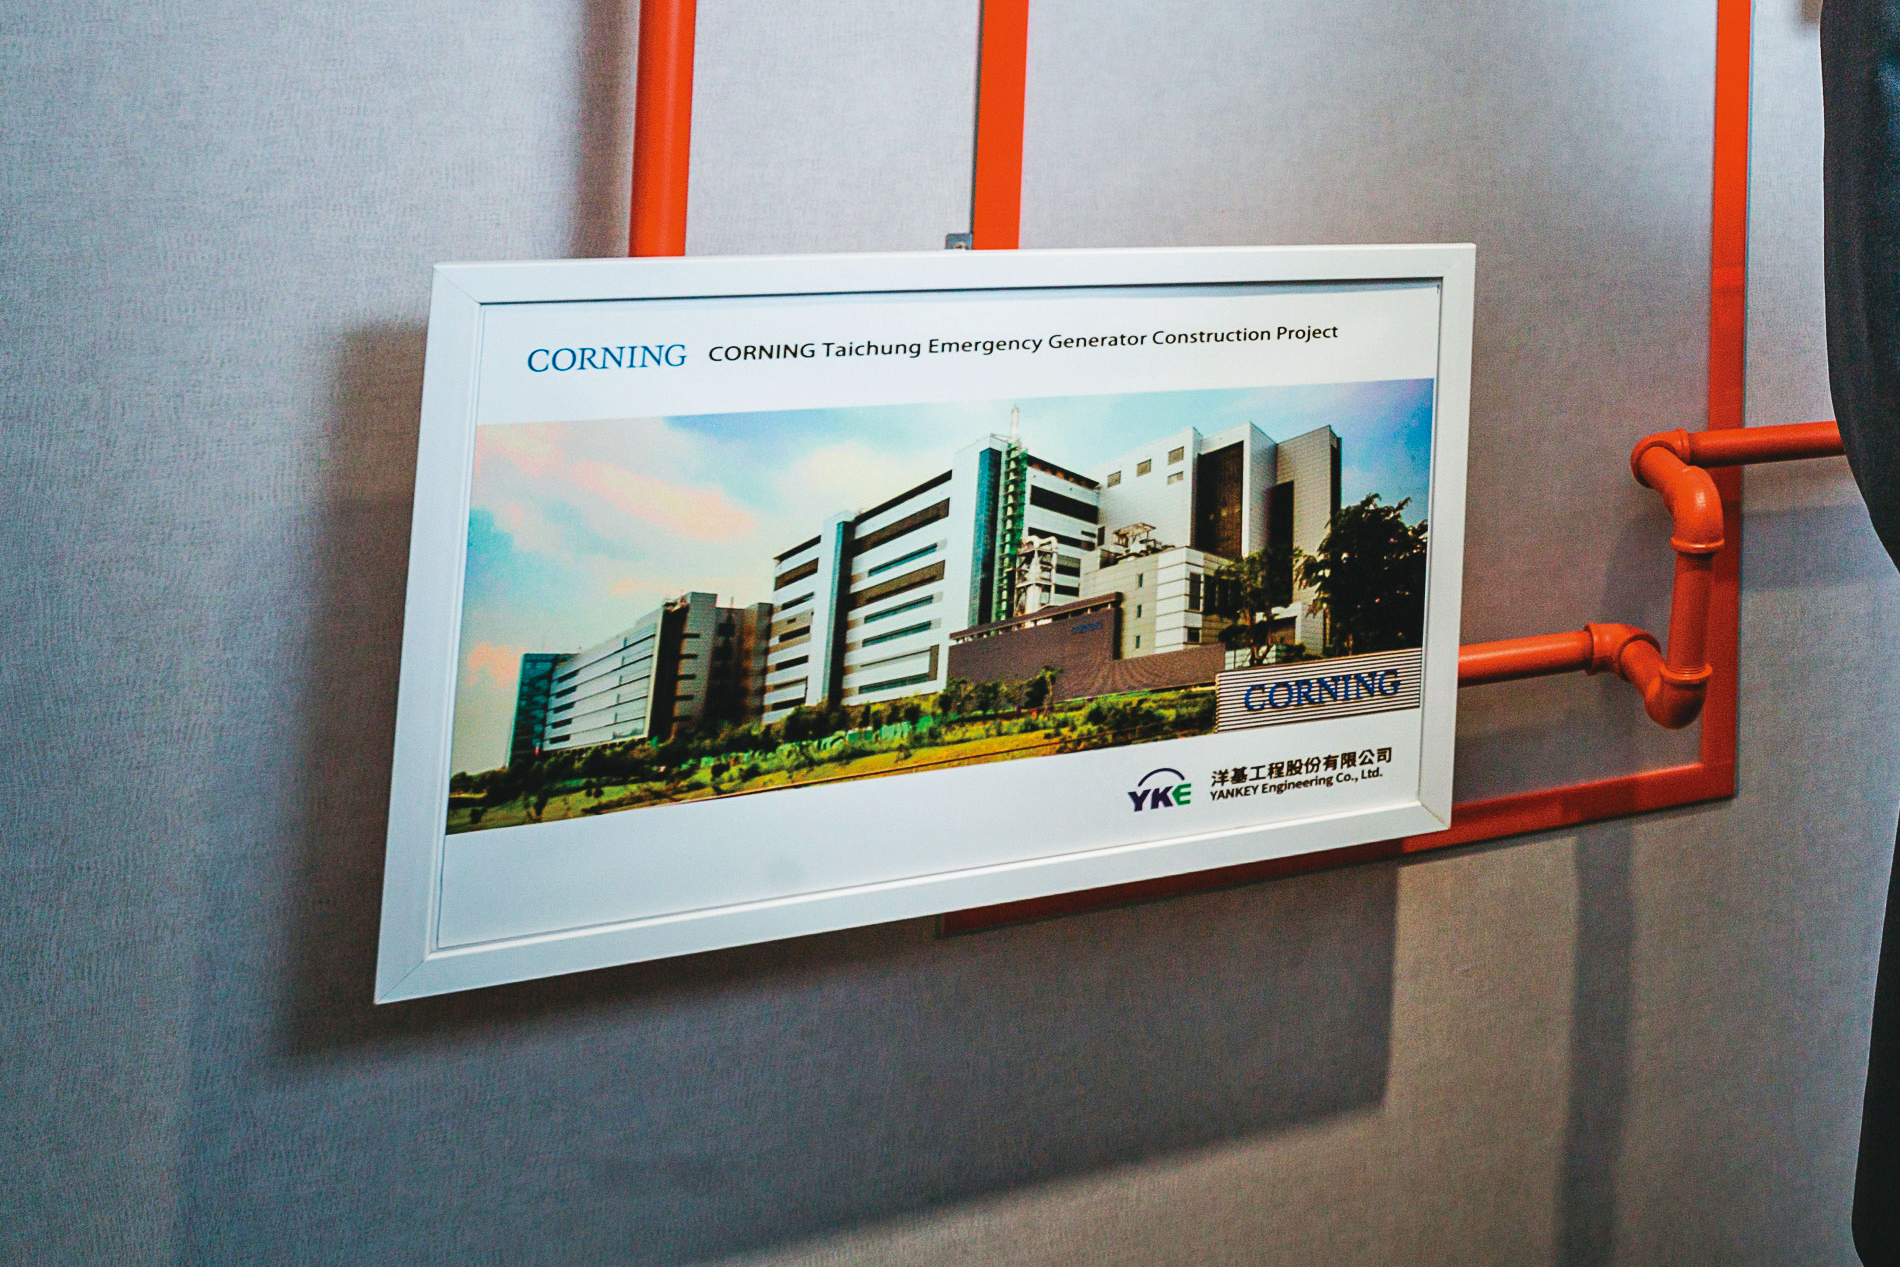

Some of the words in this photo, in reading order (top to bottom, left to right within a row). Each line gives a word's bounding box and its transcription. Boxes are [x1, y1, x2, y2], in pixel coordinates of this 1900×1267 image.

[526, 343, 688, 373] CORNING
[708, 342, 816, 362] CORNING
[821, 340, 922, 359] Taichung
[928, 336, 1043, 356] Emergency
[1048, 332, 1148, 350] Generator
[1152, 327, 1272, 346] Construction
[1276, 325, 1339, 343] Project
[1243, 668, 1400, 712] CORNING
[1210, 746, 1393, 788] 洋基工程股份有限公司
[1210, 785, 1259, 801] YANKEY
[1261, 775, 1334, 795] Engineering
[1335, 771, 1359, 784] Co.,
[1360, 766, 1384, 780] Ltd.
[1127, 782, 1192, 813] YKE
